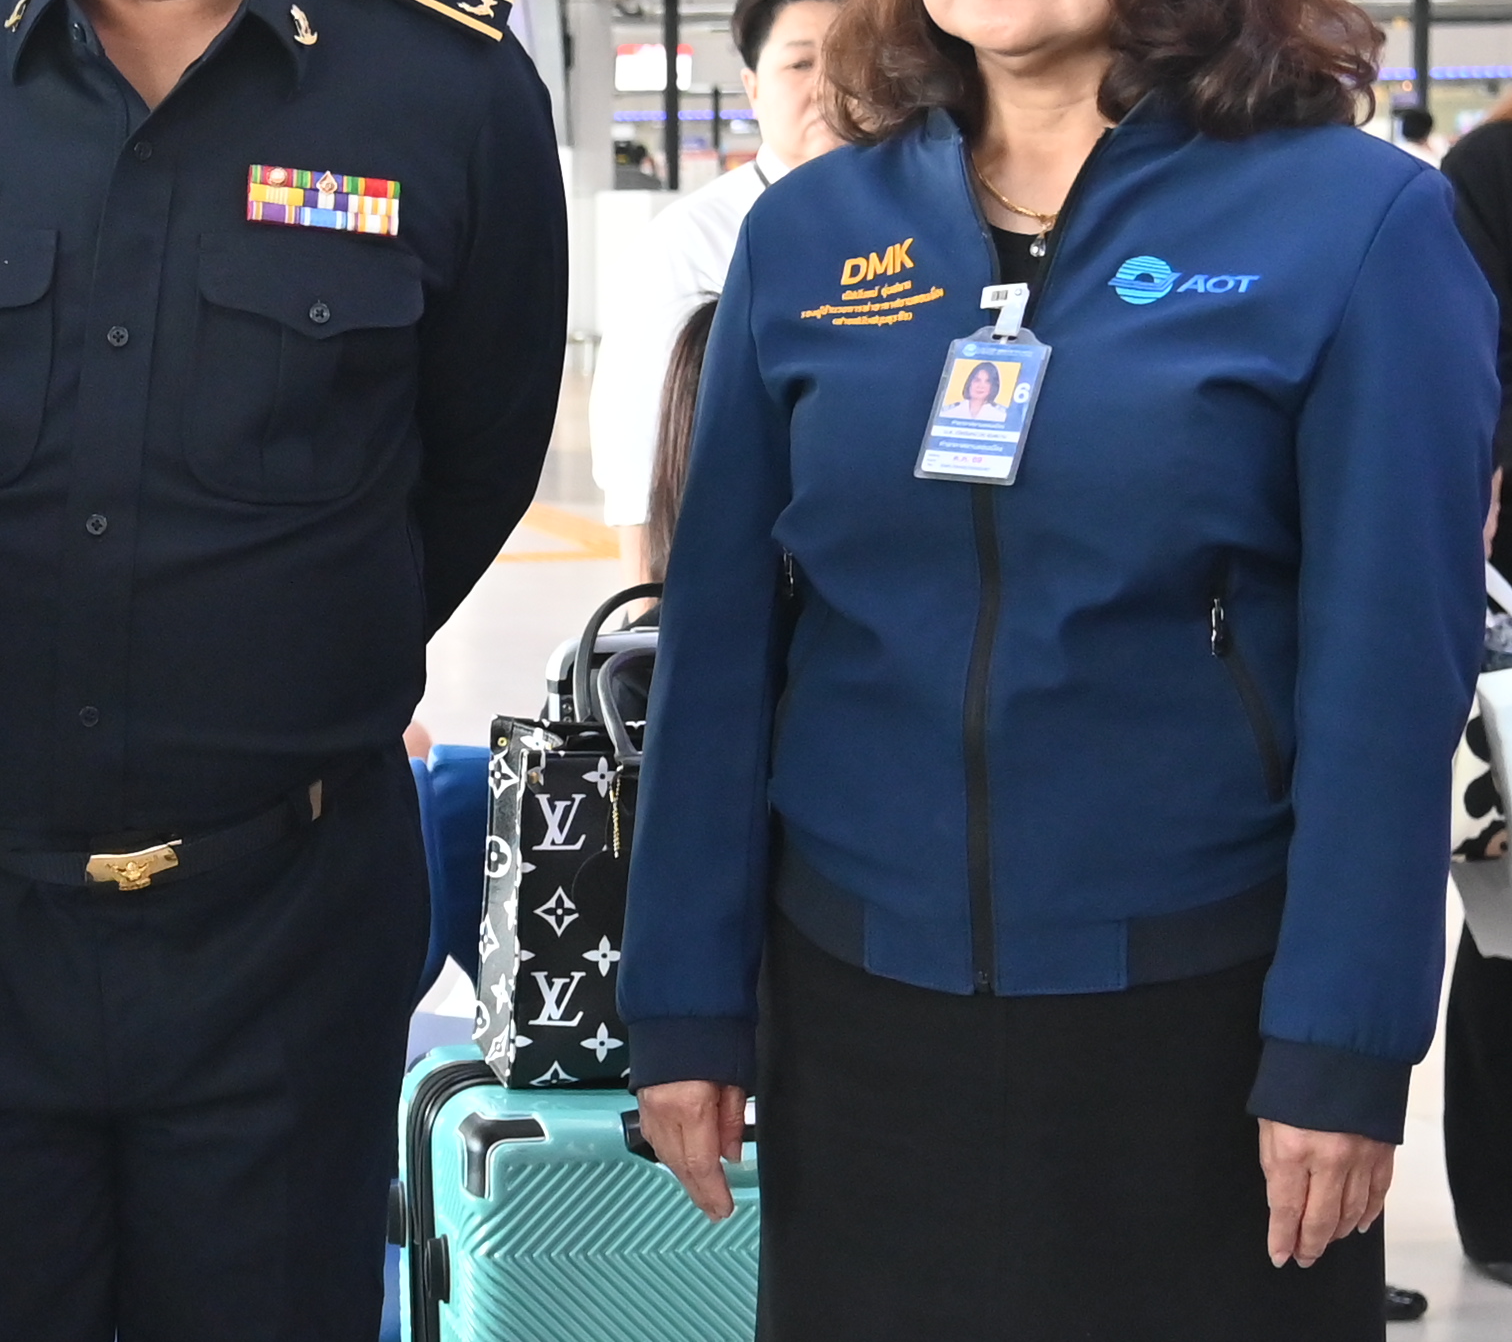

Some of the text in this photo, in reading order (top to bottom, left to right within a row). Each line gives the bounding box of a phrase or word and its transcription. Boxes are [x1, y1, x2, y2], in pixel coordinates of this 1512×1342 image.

[840, 237, 915, 286] DMK
[1176, 273, 1261, 294] AOT
[1013, 382, 1031, 404] 6
[532, 793, 586, 851] LV
[528, 971, 586, 1027] LV
